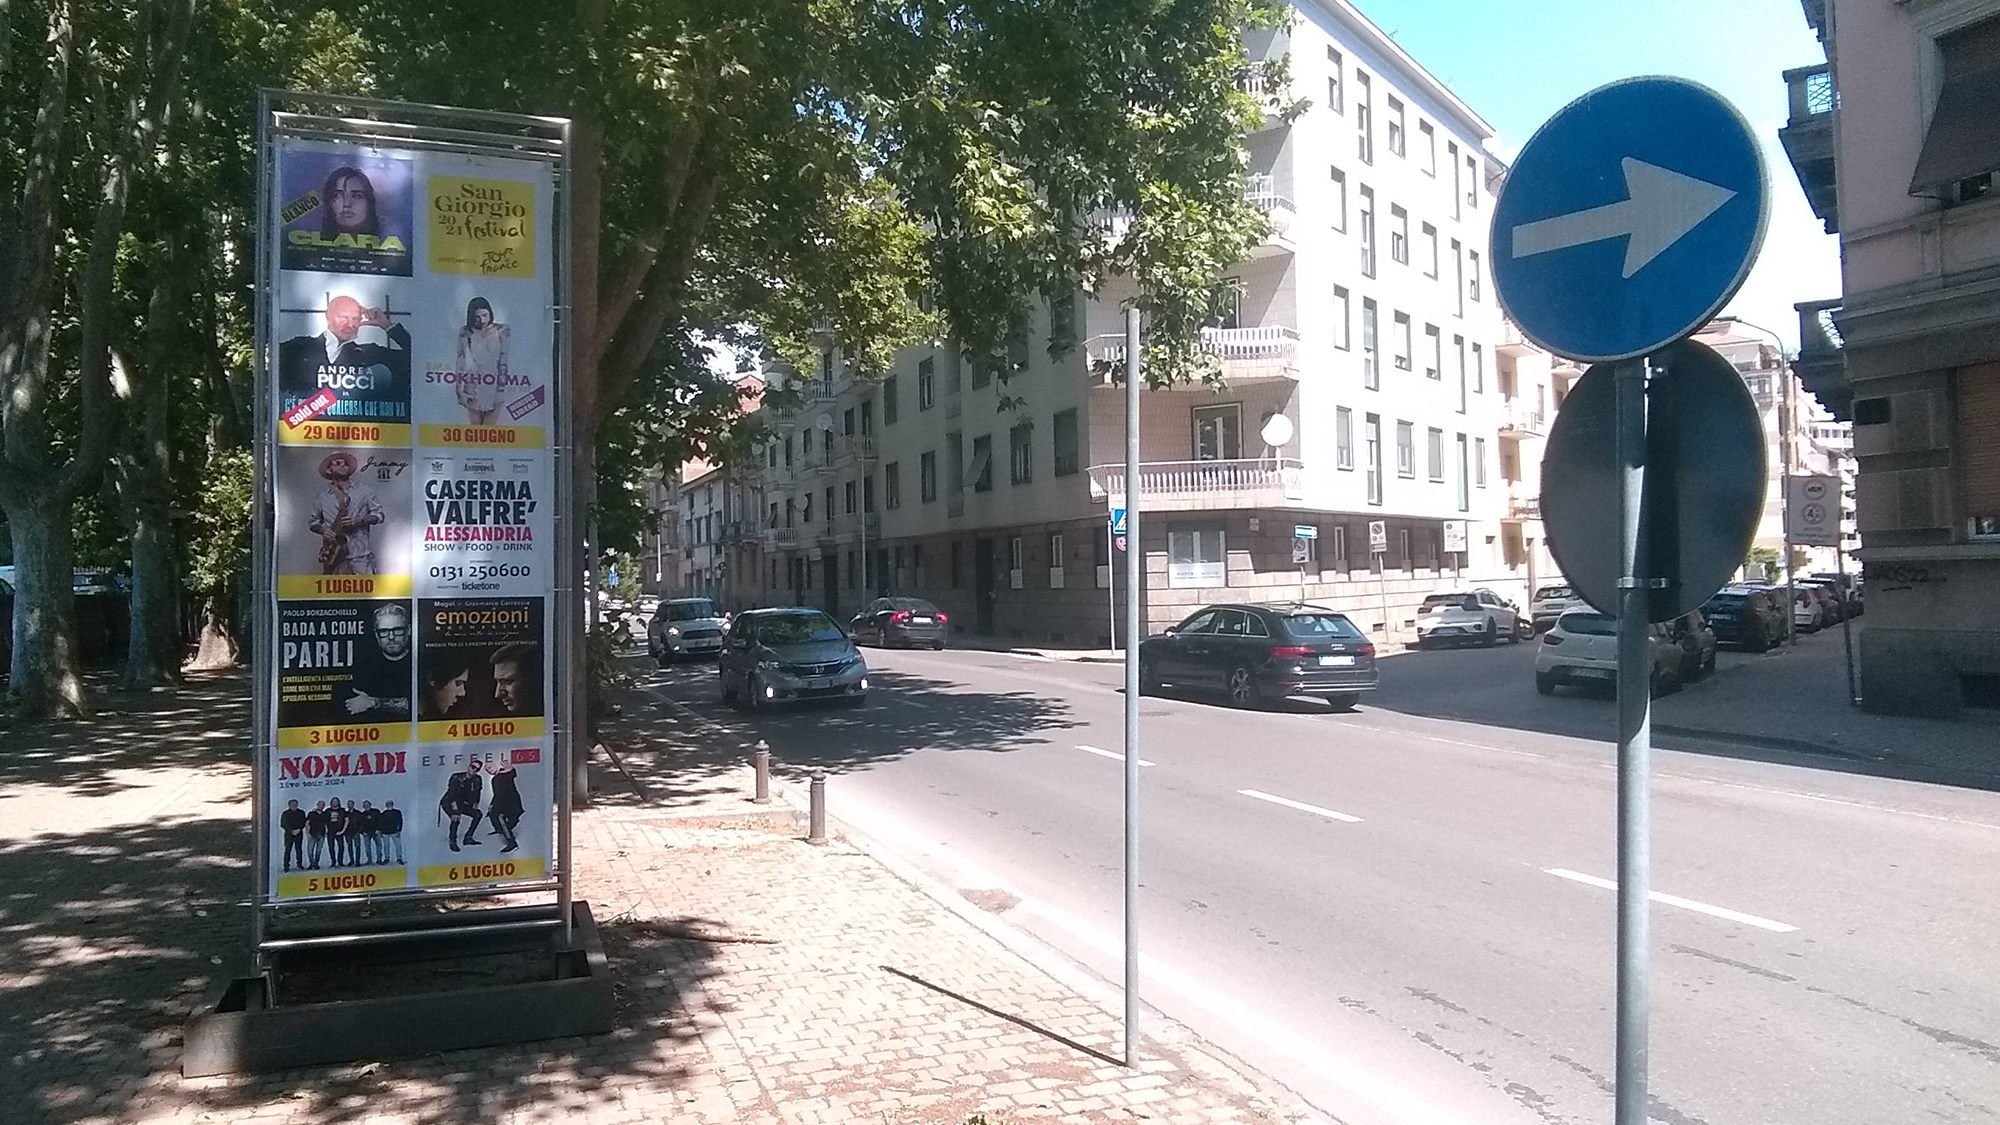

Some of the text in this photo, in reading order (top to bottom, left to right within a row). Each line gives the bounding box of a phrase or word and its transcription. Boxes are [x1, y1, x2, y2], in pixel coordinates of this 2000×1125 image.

[461, 183, 503, 201] San
[282, 194, 320, 223] BLANCO
[434, 195, 526, 220] Giorgio
[438, 214, 456, 225] 20
[464, 215, 526, 240] festival
[288, 230, 407, 251] CLARA
[317, 364, 374, 376] ANDREA
[425, 371, 532, 386] STOKHOLMA
[317, 372, 375, 390] PUCCI
[289, 404, 313, 426] sold
[310, 394, 330, 411] out
[327, 399, 363, 417] QUALCOSA
[364, 400, 377, 417] CHE
[512, 400, 539, 419] LIBERO
[303, 425, 380, 442] 29 GIUGNO
[443, 427, 516, 443] 30 GIUGNO
[425, 480, 532, 500] CASERMA
[424, 526, 533, 542] ALESSANDRIA
[424, 543, 533, 552] SHOW FOOD DRINK
[429, 563, 531, 581] 0131 250600
[315, 578, 374, 593] 1 LUGLIO
[461, 582, 500, 591] ticketone
[283, 608, 358, 617] PAOLO BORZACCHIELLO
[433, 600, 455, 609] Mogol
[435, 606, 529, 625] emozioni
[283, 620, 365, 637] BADA A COME
[282, 640, 354, 669] PARLI
[310, 727, 380, 744] 3 LUGLIO
[447, 722, 515, 737] 4 LUGLIO
[278, 751, 407, 781] NOMADI
[422, 751, 536, 767] EIFFEL 65
[279, 781, 300, 789] live
[325, 778, 345, 786] 2024
[449, 863, 516, 881] 6 LUGLIO
[308, 875, 376, 891] 5 LUGLIO
